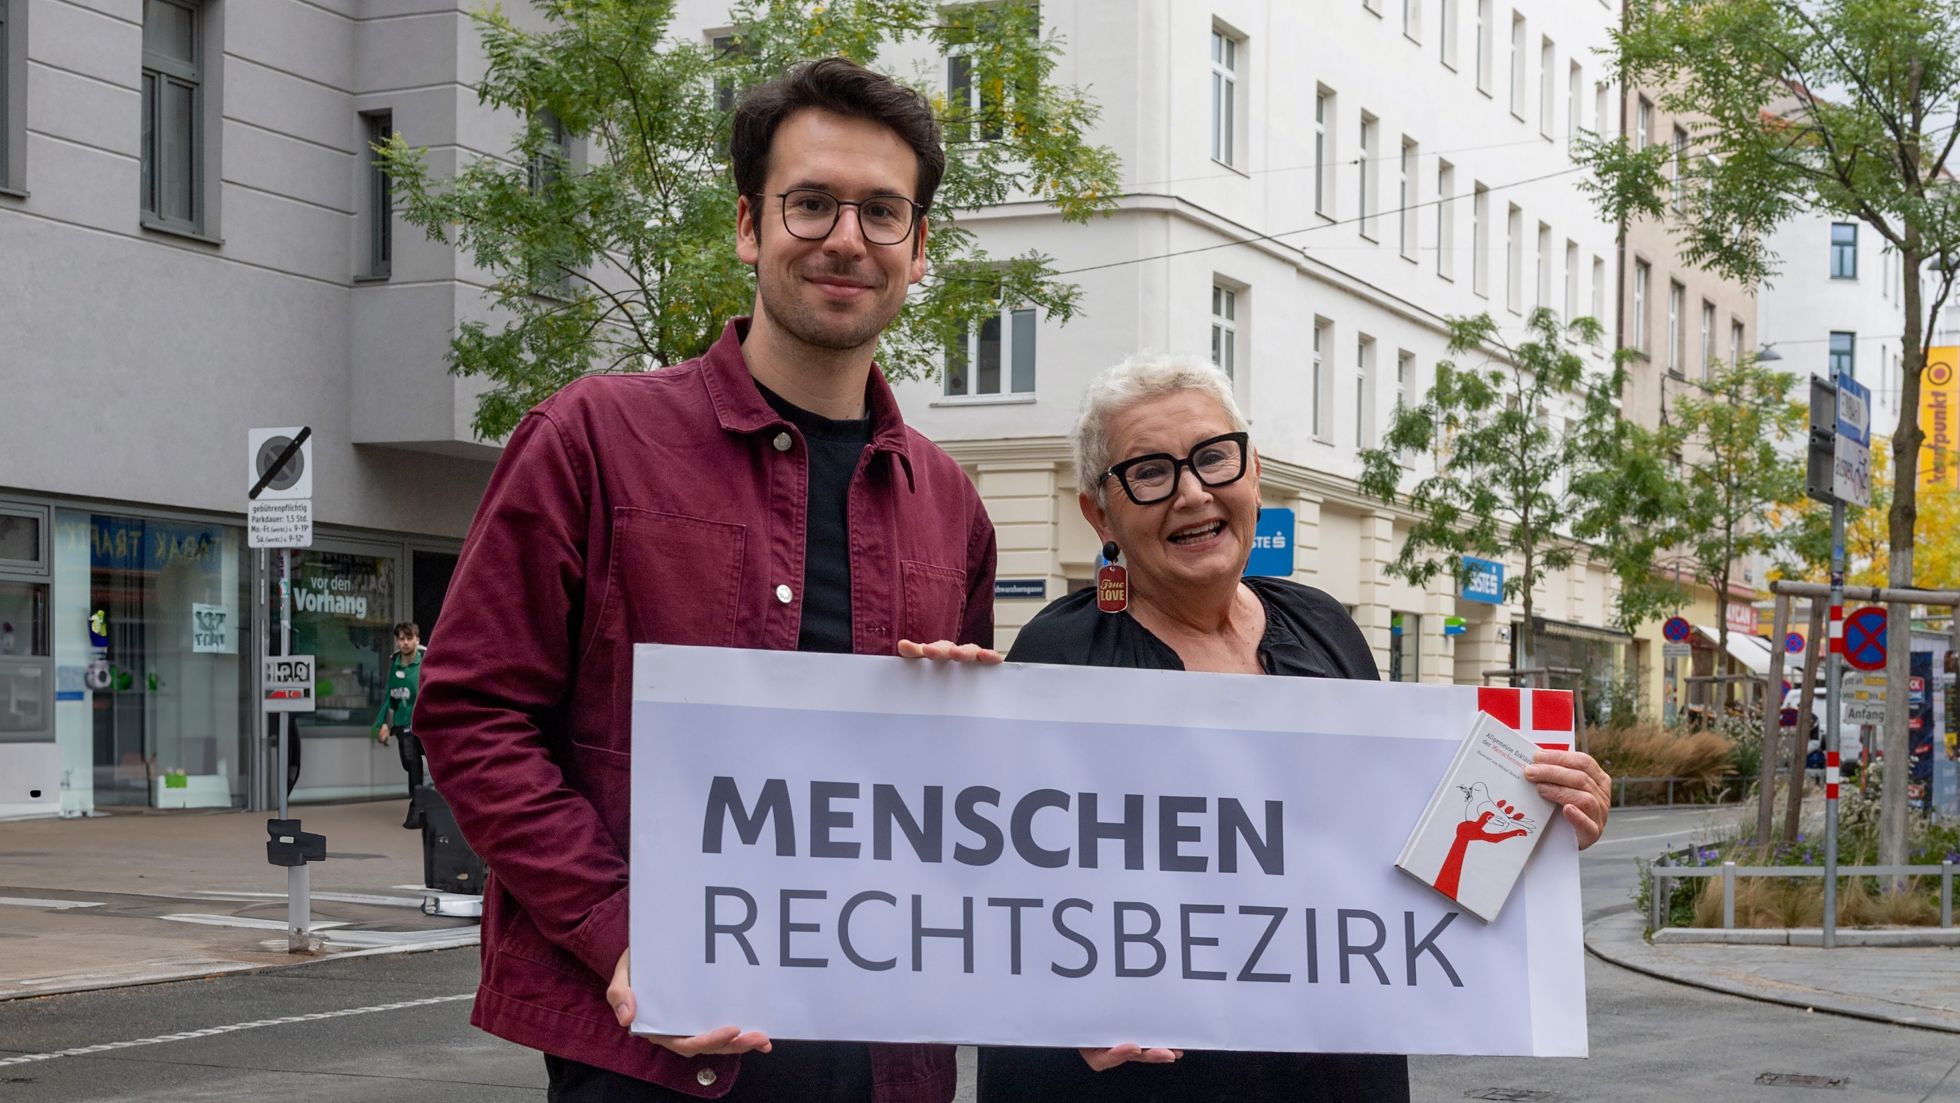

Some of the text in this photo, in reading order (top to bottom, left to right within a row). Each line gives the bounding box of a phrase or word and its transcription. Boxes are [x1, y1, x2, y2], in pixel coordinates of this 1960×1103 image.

[1926, 391, 1950, 484] kaufpunkt
[253, 504, 307, 513] gebührenpflichtig
[251, 514, 308, 523] Parkdauer: 1,5 Std.
[310, 576, 328, 590] vor
[330, 576, 351, 591] den
[1100, 578, 1125, 590] True
[1100, 589, 1125, 601] LOVE
[293, 587, 367, 620] Vorhang
[1848, 708, 1885, 723] Anfang
[1482, 739, 1492, 748] der
[702, 775, 1285, 876] MENSCHEN
[704, 885, 1464, 988] RECHTSBEZIRK
